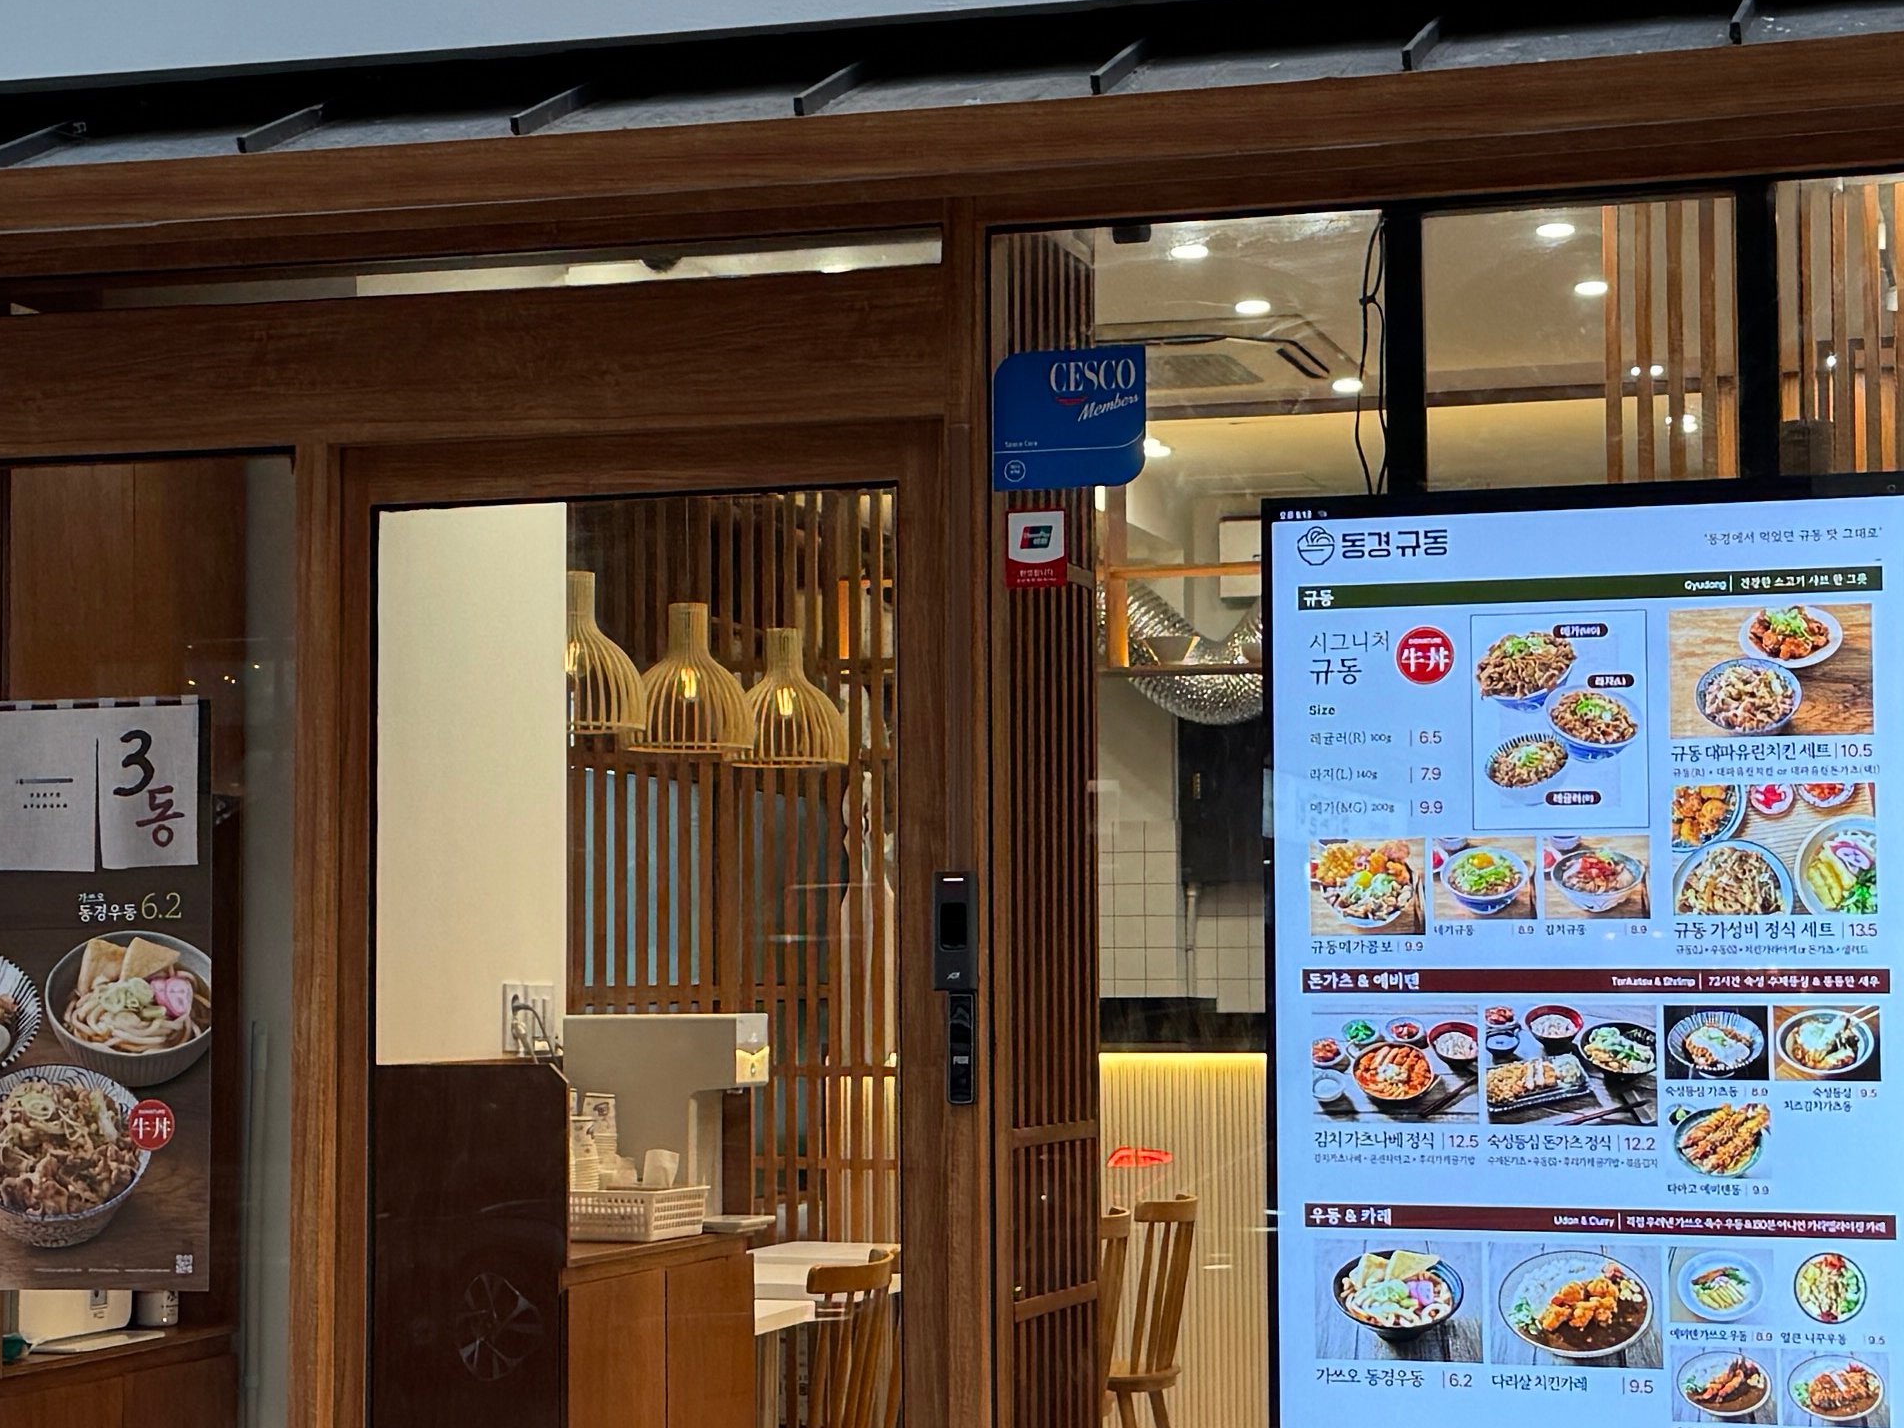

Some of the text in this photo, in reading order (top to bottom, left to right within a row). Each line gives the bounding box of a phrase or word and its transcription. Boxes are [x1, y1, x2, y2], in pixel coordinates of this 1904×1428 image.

[1049, 358, 1136, 393] CESCO
[1077, 393, 1139, 422] Members
[1774, 574, 1806, 589] 소고기
[1303, 589, 1335, 608] 규동
[1309, 629, 1390, 654] 시그니처
[1401, 646, 1450, 674] 牛丼
[1309, 658, 1363, 686] 규동
[1309, 704, 1336, 717] Size
[1309, 730, 1367, 746] 레귤러(R)
[1419, 730, 1443, 745] 6.5
[1671, 743, 1703, 763] 규동
[1799, 741, 1832, 760] 세트
[1840, 743, 1874, 759] 10.5
[1309, 767, 1354, 783] 라지(L)
[1420, 767, 1442, 781] 7.9
[1419, 800, 1444, 815] 9.9
[78, 891, 183, 923] 동경우동 6.2
[1674, 921, 1879, 940] 규동 가성비 정식 세트 13.5
[1307, 972, 1354, 991] 돈가츠
[1357, 974, 1369, 990] &
[1708, 974, 1741, 989] 72시간
[132, 1117, 172, 1140] 牛丼
[1313, 1130, 1479, 1151] 김치 가츠나베 정식 12.5
[1487, 1134, 1656, 1152] 숙성등심 돈가츠 정식 12.2
[1309, 1207, 1392, 1227] 우동 & 카레
[1316, 1367, 1473, 1388] 가쓰오 동경우동 6.2
[1491, 1374, 1532, 1392] 다리살
[1628, 1379, 1654, 1394] 9.5
